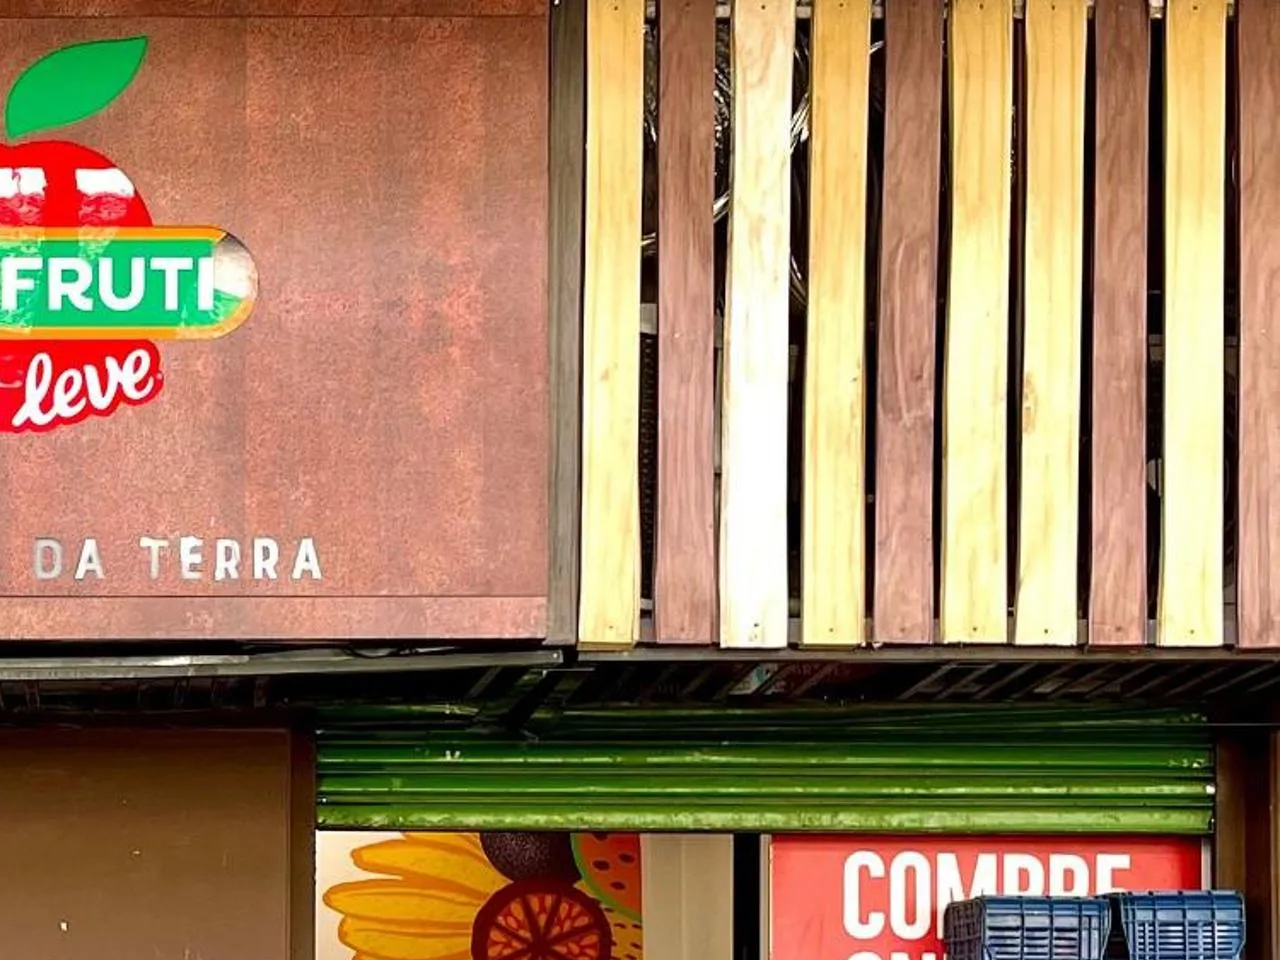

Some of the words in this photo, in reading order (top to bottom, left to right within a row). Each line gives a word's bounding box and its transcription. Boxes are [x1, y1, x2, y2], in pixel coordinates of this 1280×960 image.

[11, 347, 156, 428] leve
[32, 537, 106, 581] DA
[139, 535, 323, 582] TERRA
